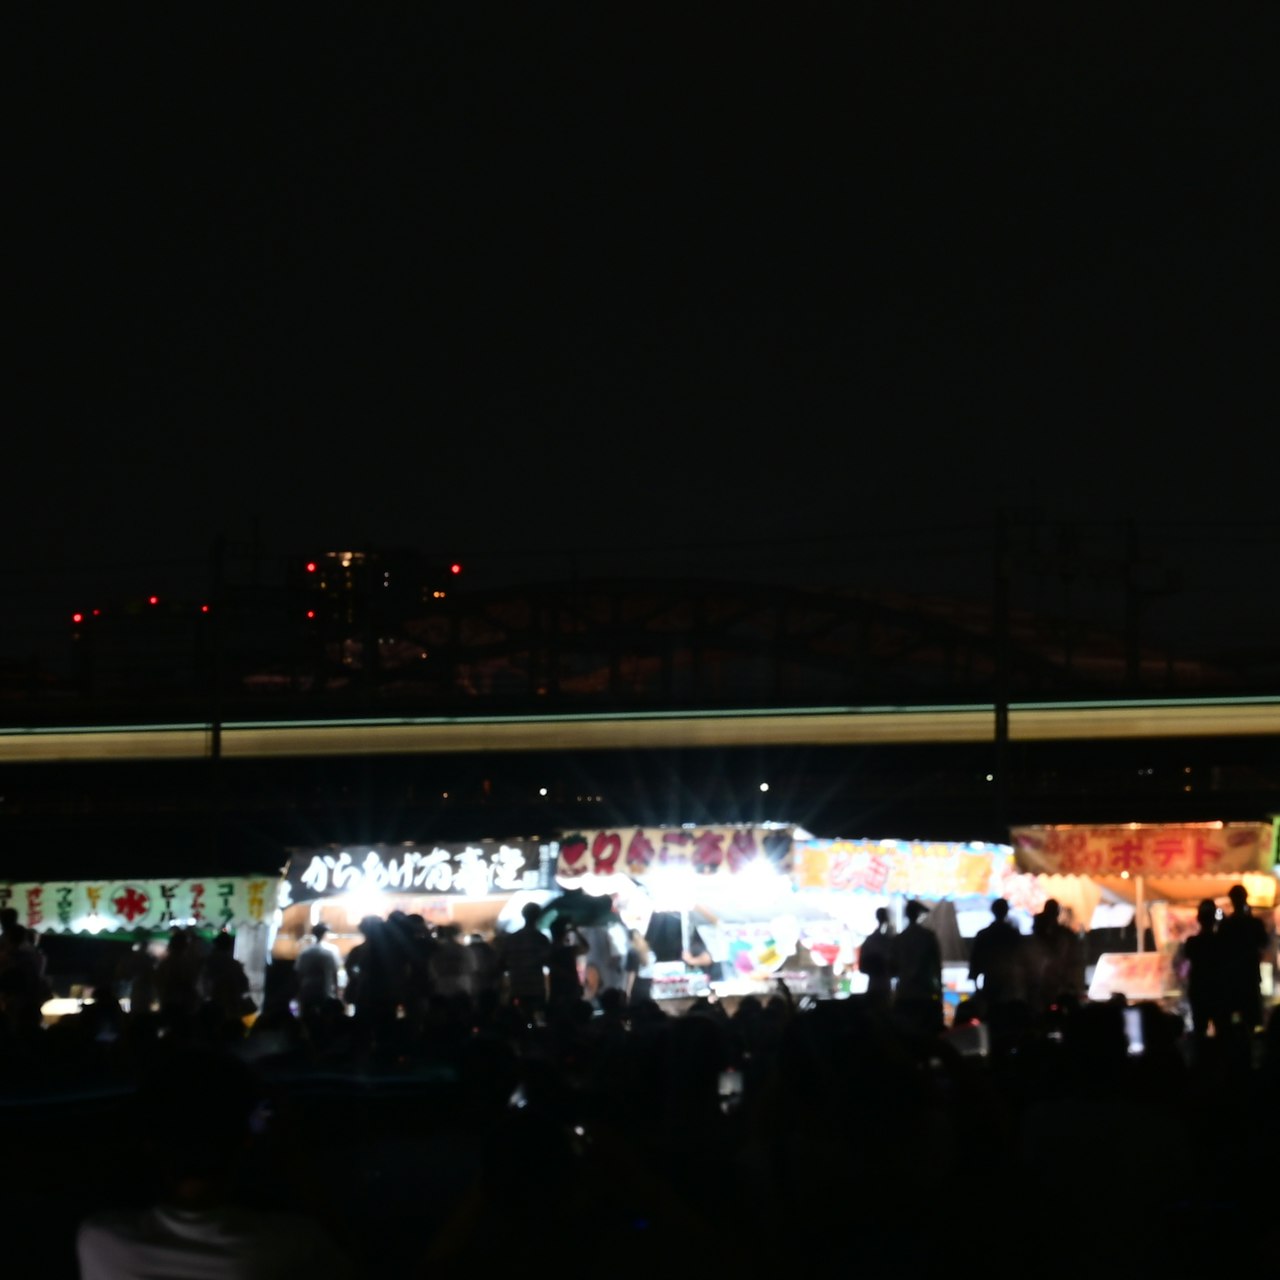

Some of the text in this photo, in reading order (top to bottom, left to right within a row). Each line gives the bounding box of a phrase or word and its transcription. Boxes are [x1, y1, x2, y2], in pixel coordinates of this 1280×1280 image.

[1111, 833, 1223, 870] ポテト
[160, 885, 178, 922] ビール
[217, 883, 234, 923] コーラ
